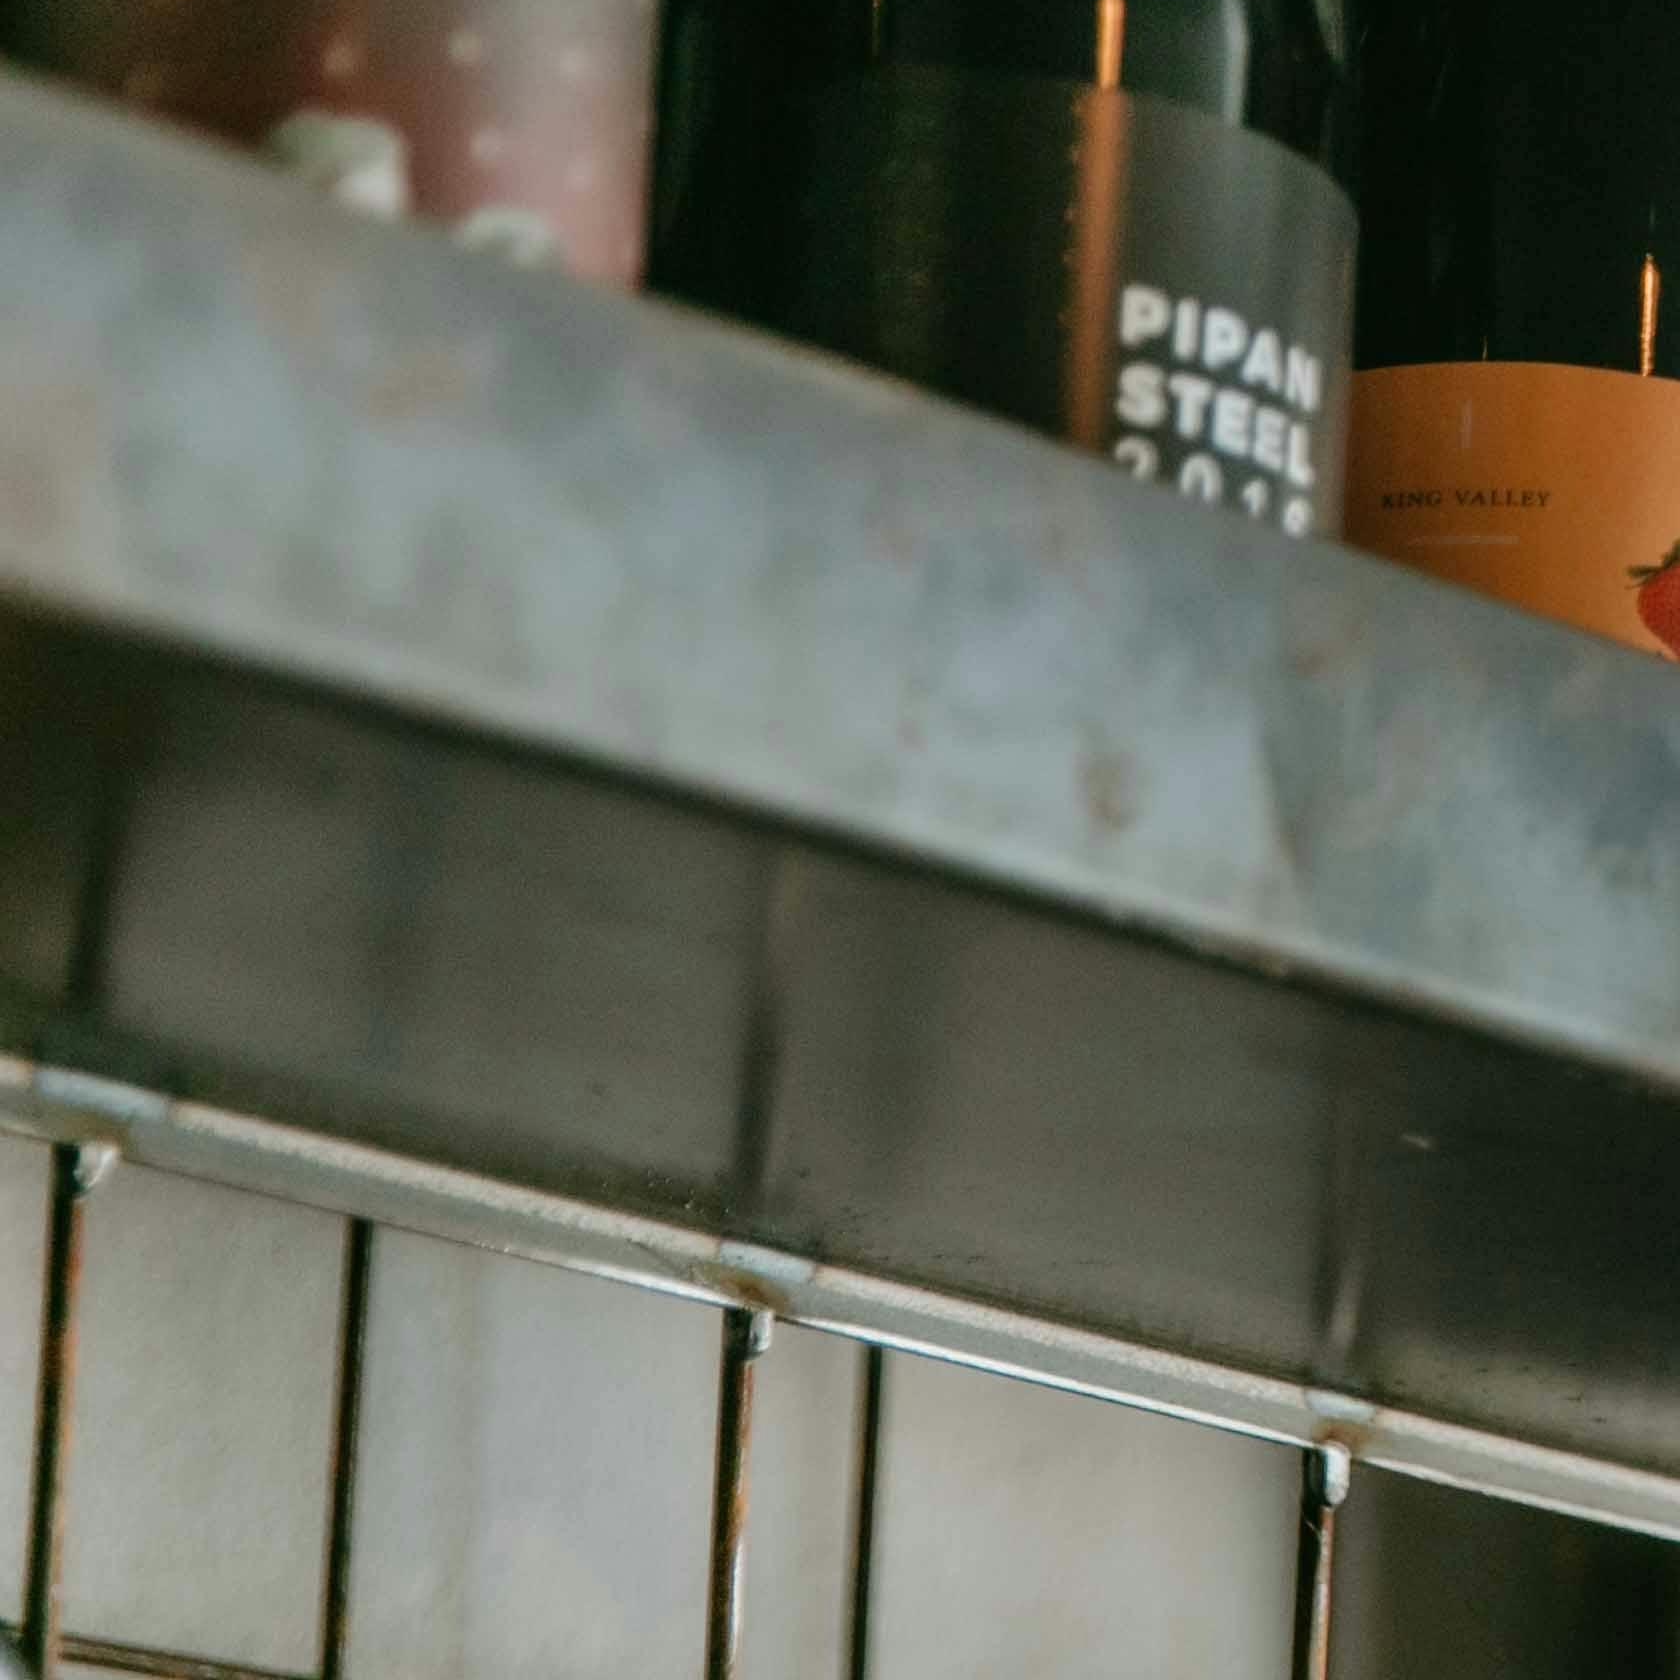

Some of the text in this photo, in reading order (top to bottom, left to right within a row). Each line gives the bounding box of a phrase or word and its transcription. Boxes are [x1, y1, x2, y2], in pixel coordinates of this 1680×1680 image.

[1118, 282, 1324, 414] PIPAN
[1114, 361, 1315, 490] STEEL
[1380, 488, 1552, 511] KING VALLEY
